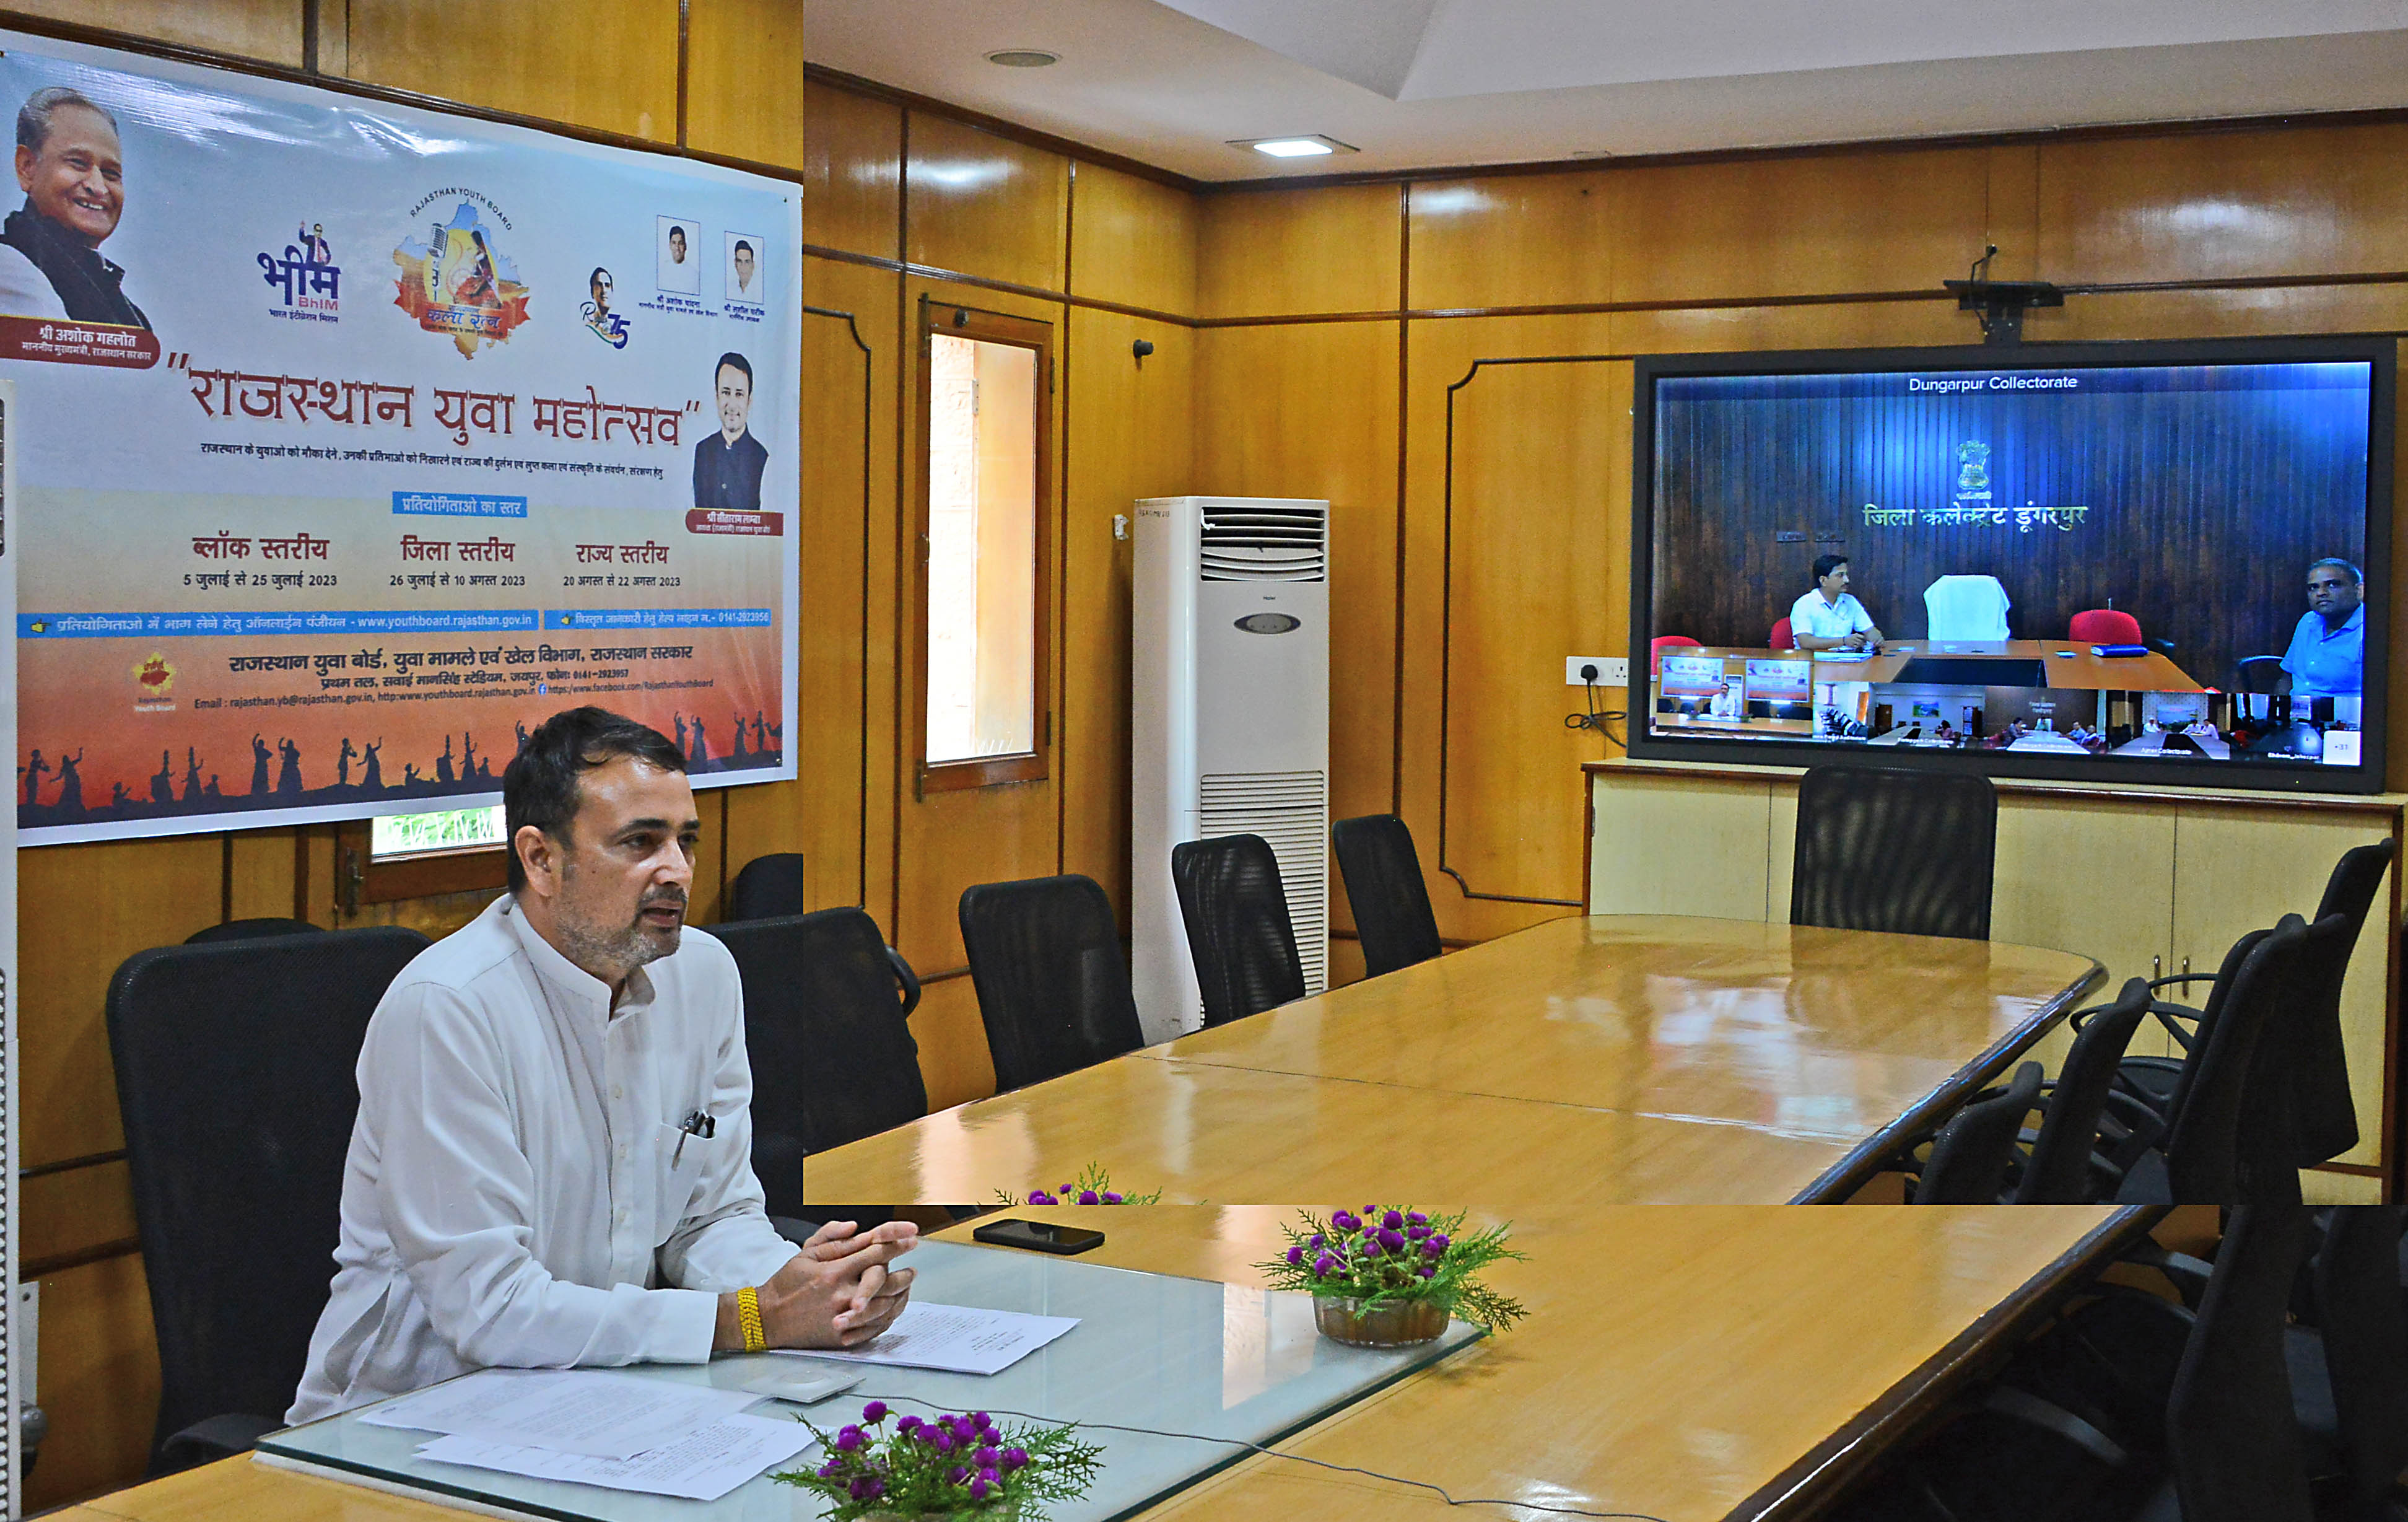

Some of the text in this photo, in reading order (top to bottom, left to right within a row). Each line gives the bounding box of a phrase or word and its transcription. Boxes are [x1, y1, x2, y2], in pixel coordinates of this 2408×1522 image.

[410, 188, 512, 230] RAJASTHAN YOUTH BOARD
[257, 245, 341, 305] भीम
[269, 308, 287, 318] भारत
[299, 297, 338, 310] BhIM
[427, 308, 464, 325] कला
[39, 325, 136, 347] श्री अशोक गहलोत
[22, 341, 53, 351] माननीय
[92, 348, 125, 358] राजस्थान
[126, 351, 151, 360] सरकार
[1909, 376, 2077, 393] Dungarpur Collectorate
[434, 387, 515, 446] युवा
[201, 443, 242, 454] राजस्थान
[245, 443, 254, 455] के
[287, 445, 300, 457] को
[342, 449, 367, 461] उनकी
[406, 452, 417, 463] को
[419, 452, 450, 465] निखारने
[452, 455, 461, 466] एवं
[464, 457, 481, 466] राज्य
[483, 457, 494, 468] की
[514, 458, 524, 469] एवं
[541, 461, 557, 471] कला
[558, 461, 568, 472] एवं
[595, 462, 603, 473] के
[653, 466, 663, 480] हेतु
[480, 501, 496, 514] का
[499, 501, 521, 515] स्तर
[1862, 503, 1916, 527] जिला
[2013, 501, 2088, 533] डूंगरपुर
[192, 530, 330, 559] ब्लॉक स्तरीय
[400, 535, 515, 562] जिला स्तरीय
[575, 540, 670, 564] राज्य स्तरीय
[183, 570, 338, 590] 5 जुलाई से 25 जुलाई 2023
[390, 571, 526, 590] 26 जुलाई से 10 अगस्त 2023
[563, 573, 681, 587] 20 अगस्त से 22 अगस्त 2023
[147, 616, 160, 629] में
[165, 619, 191, 629] भाग
[196, 615, 217, 629] लेने
[222, 615, 242, 632] हेतु
[246, 614, 302, 631] ऑनलाईन
[307, 614, 346, 628] पंजीयन
[357, 614, 532, 629] www.youthboard.rajasthan.gov.in
[229, 644, 693, 676] राजस्थान युवा बोर्ड, युवा मामले एवं खेल विभाग, राजस्थान सरकार
[321, 678, 350, 689] प्रथम
[354, 676, 378, 688] तल,
[382, 673, 413, 687] सवाई
[416, 671, 460, 685] मानसिंह
[194, 698, 221, 709] Email
